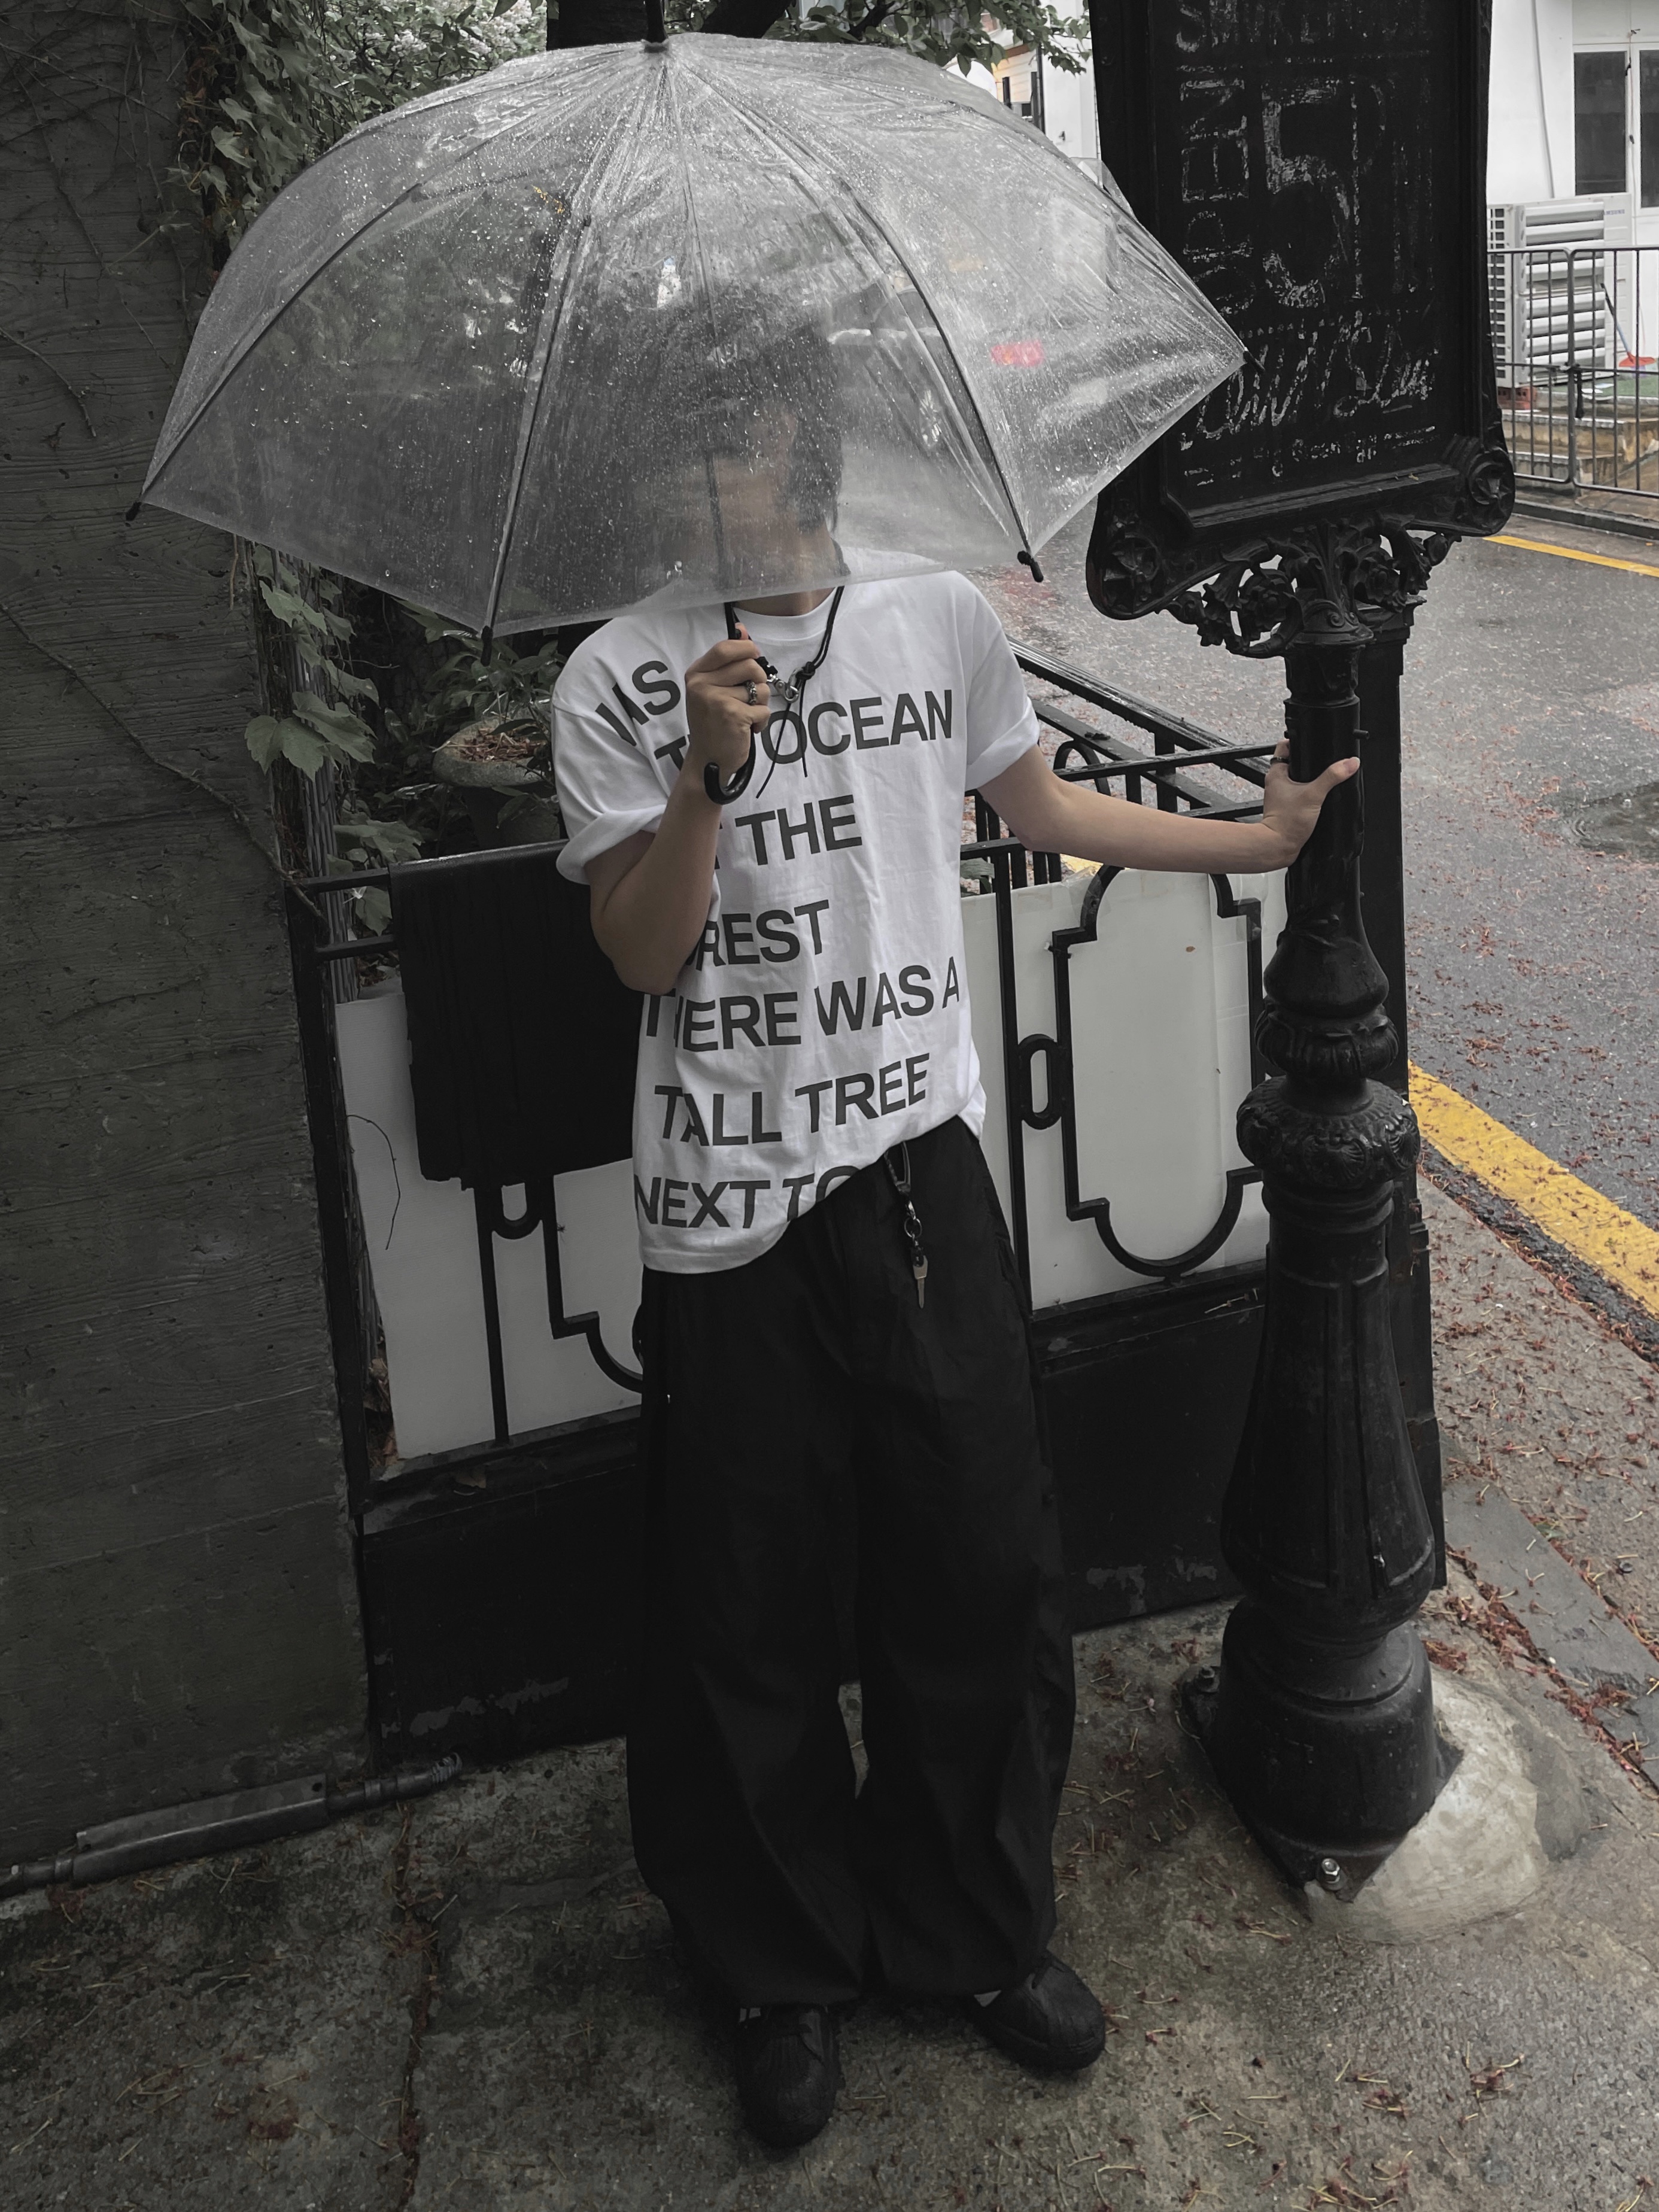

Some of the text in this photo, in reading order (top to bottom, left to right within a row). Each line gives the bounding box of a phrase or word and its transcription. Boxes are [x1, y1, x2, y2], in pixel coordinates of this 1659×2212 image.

[762, 689, 952, 764] OCEAN
[735, 794, 862, 866] THE
[686, 899, 830, 971] REST
[646, 956, 959, 1052] TERE WAS A
[654, 1053, 930, 1147] TALL TREE
[634, 1174, 771, 1229] NEXT
